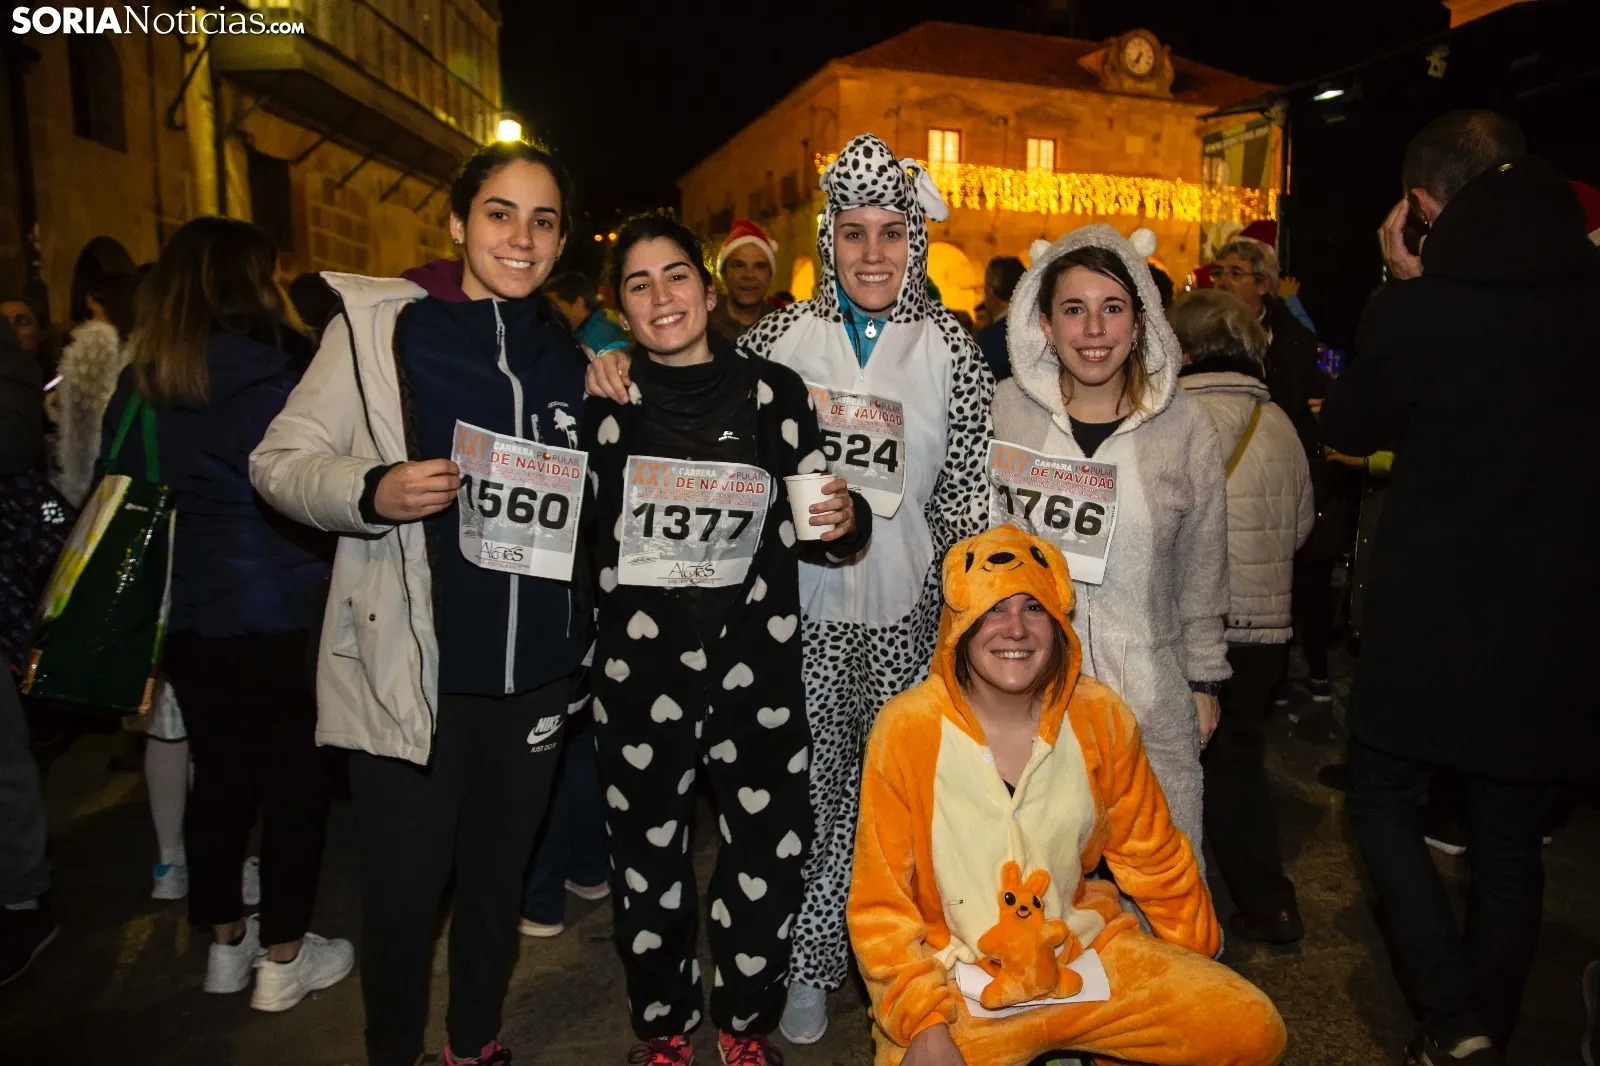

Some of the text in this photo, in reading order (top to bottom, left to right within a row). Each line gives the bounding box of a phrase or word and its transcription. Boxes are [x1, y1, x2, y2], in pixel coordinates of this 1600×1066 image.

[831, 404, 845, 415] DE
[836, 396, 867, 407] ARRERA
[493, 442, 534, 457] CARRERA
[537, 452, 579, 466] POPULAR
[820, 429, 898, 473] 524
[490, 451, 511, 465] DE
[516, 457, 580, 479] NAVIDAD
[678, 467, 716, 477] CARRERA
[1035, 459, 1072, 471] CARRERA
[1075, 465, 1112, 476] POPULAR
[676, 477, 765, 494] DE NAVIDAD
[1030, 467, 1049, 478] DE
[1054, 471, 1114, 489] NAVIDAD
[460, 474, 570, 530] 1560
[999, 485, 1105, 536] 1766
[632, 502, 754, 542] 1377
[534, 714, 561, 732] NIKE
[530, 745, 544, 753] JUST
